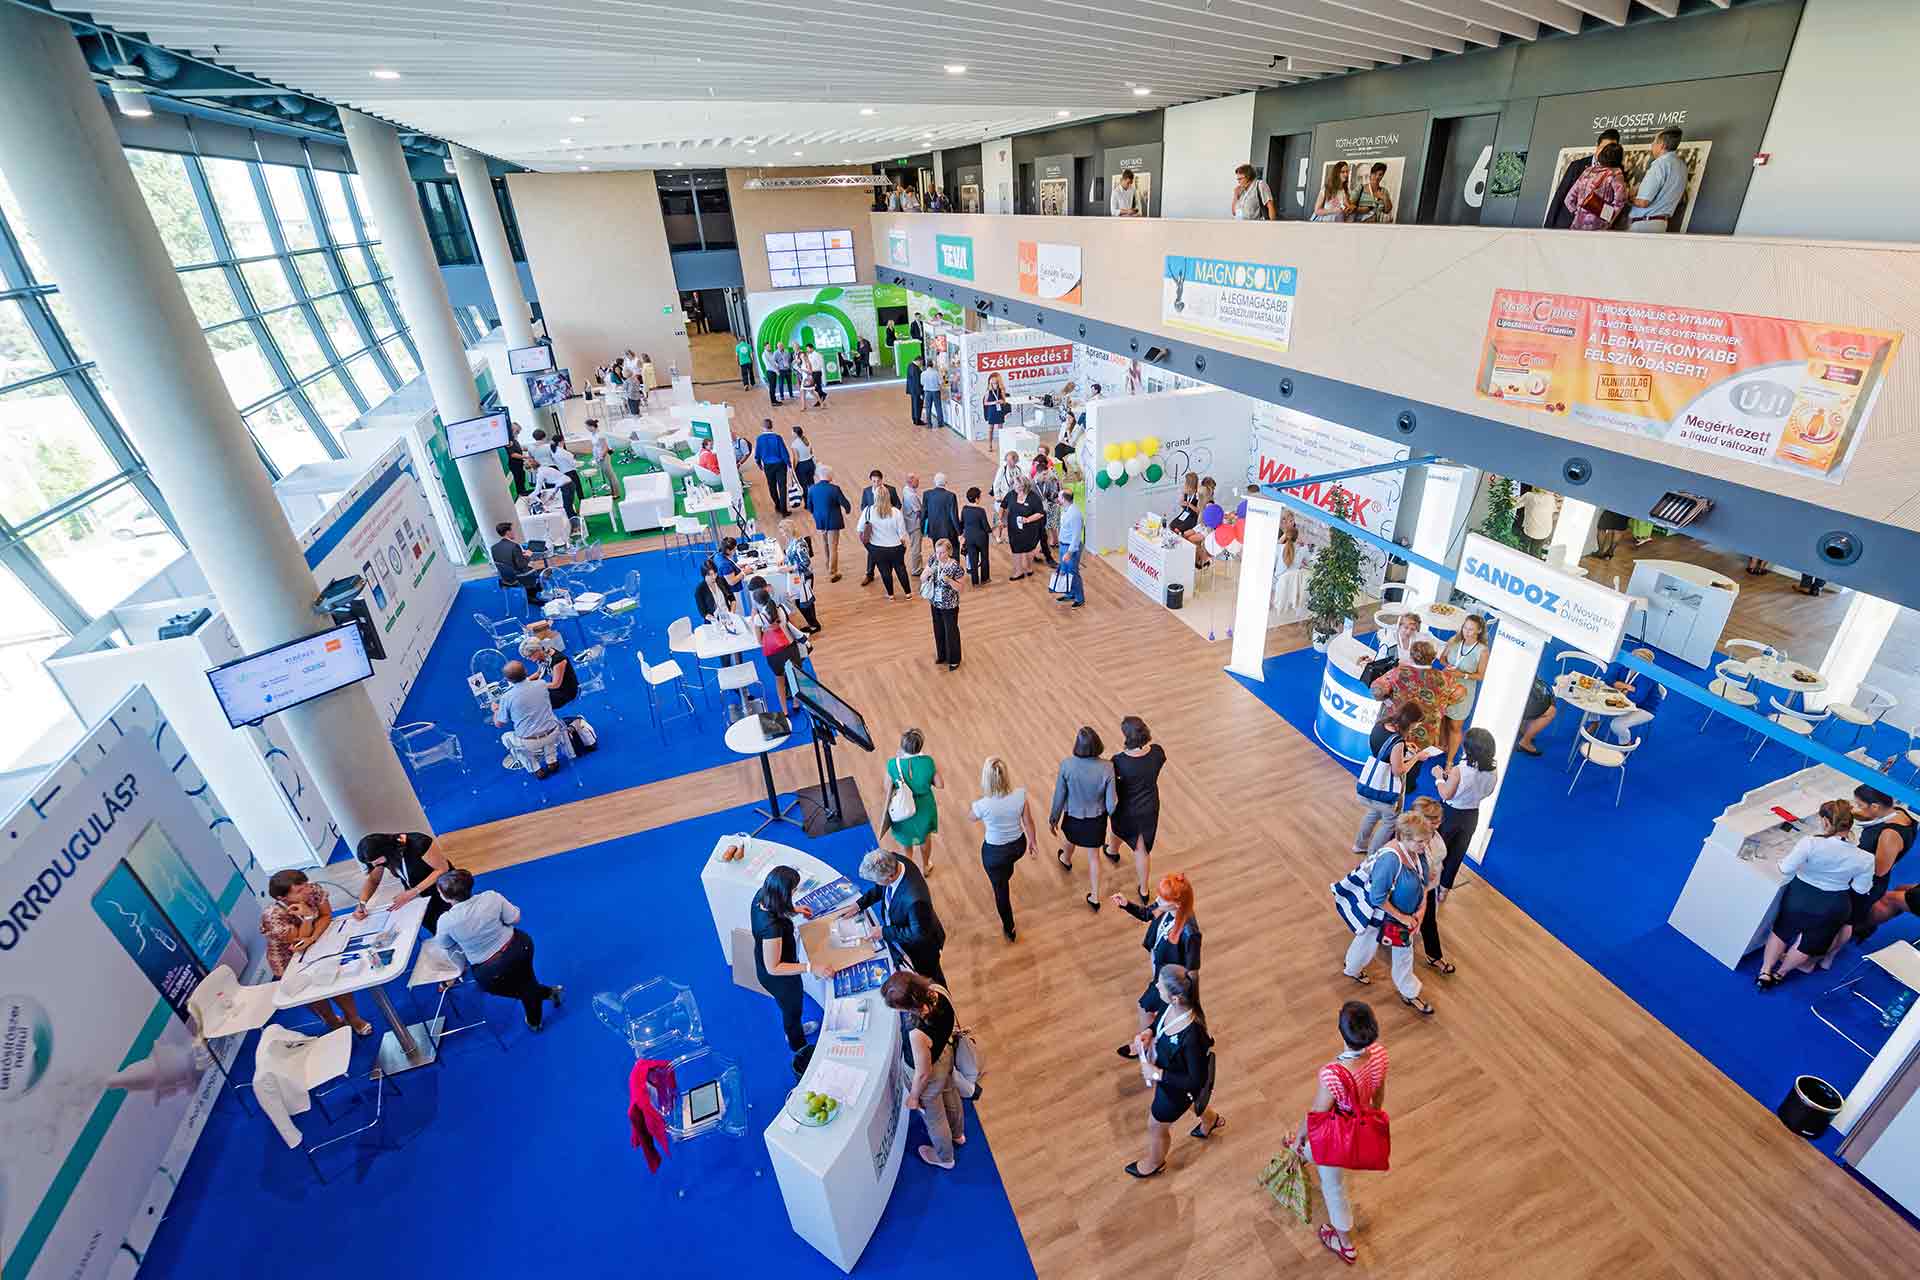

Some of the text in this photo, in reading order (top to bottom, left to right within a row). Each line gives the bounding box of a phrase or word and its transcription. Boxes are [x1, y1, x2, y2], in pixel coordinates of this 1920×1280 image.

[1592, 110, 1688, 129] SCHLOSSER IMRE
[1464, 145, 1493, 208] 6
[1667, 313, 1725, 328] C-VITAMIN
[981, 349, 1070, 370] Székrekedés?
[1587, 334, 1738, 364] A LEGHATÉKONYABB
[1008, 365, 1070, 381] STADALAX
[1739, 384, 1786, 417] ÚJ!
[1683, 414, 1772, 443] Megérkezett
[1165, 437, 1191, 450] grand
[1688, 429, 1723, 446] liquid
[1719, 438, 1768, 457] változat!
[1128, 551, 1160, 582] WALMARK
[1465, 556, 1560, 615] SANDOZ
[1560, 608, 1600, 633] Division
[1573, 600, 1617, 632] Novartis
[1498, 629, 1528, 648] SANDOZ
[0, 772, 139, 951] ORRDUGULÁS?
